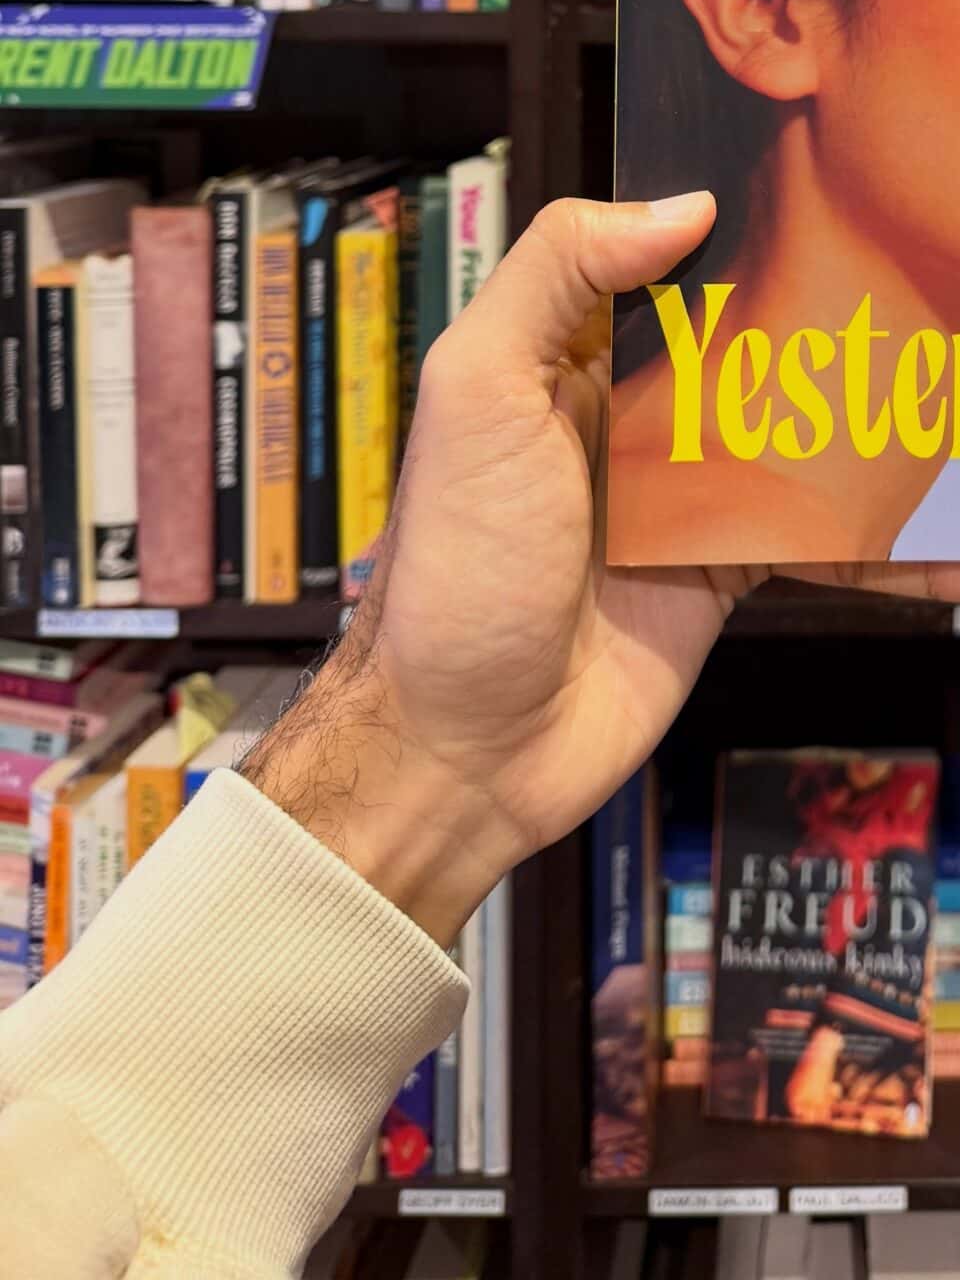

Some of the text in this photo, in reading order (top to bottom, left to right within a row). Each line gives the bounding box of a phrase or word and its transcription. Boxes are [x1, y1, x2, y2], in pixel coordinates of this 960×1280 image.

[100, 39, 259, 89] DALTON
[458, 187, 482, 242] Your
[742, 854, 914, 892] ESTHER
[728, 889, 927, 939] FREUD
[720, 934, 924, 980] hideous kinky
